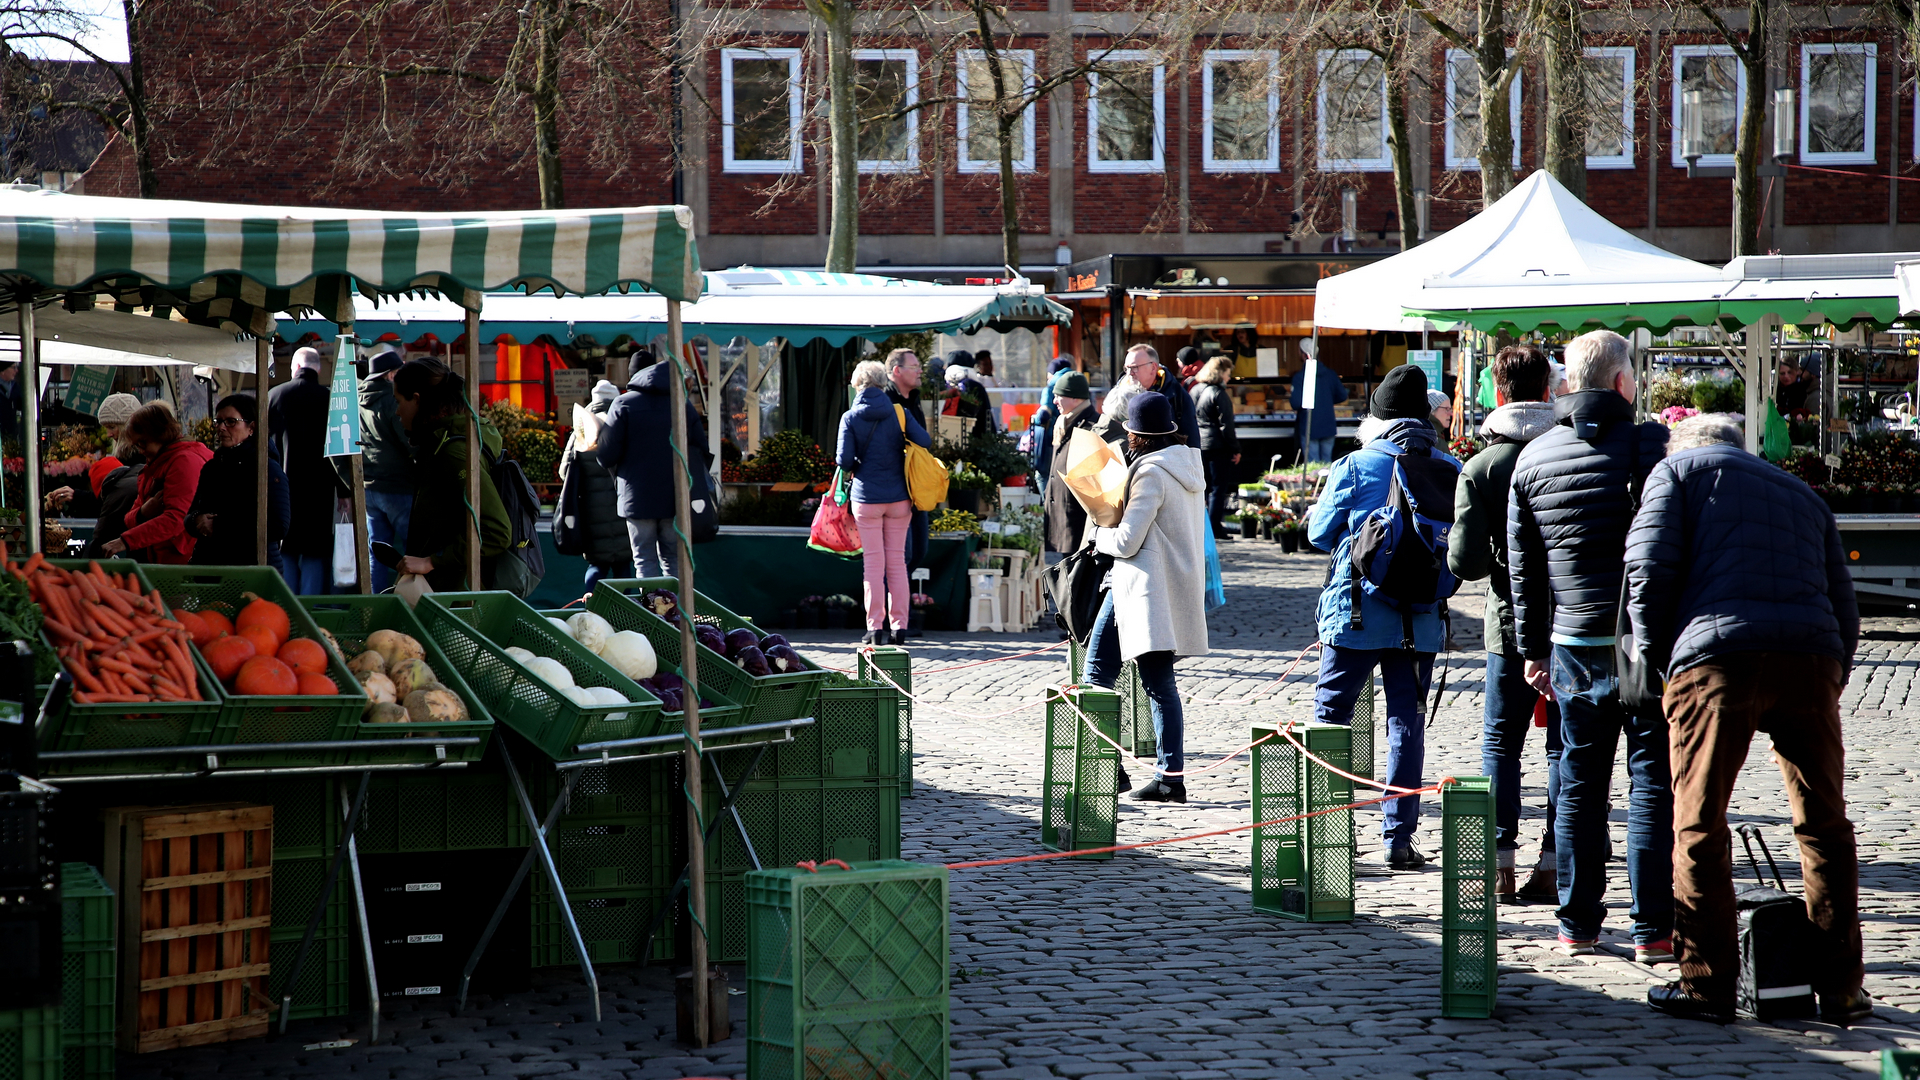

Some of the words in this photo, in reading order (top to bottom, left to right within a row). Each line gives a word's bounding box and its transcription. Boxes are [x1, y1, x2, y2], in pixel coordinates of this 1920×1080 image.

[76, 375, 97, 388] HALTEN
[97, 382, 106, 391] SIE
[339, 379, 350, 393] SIE
[76, 384, 102, 397] ABSTAND
